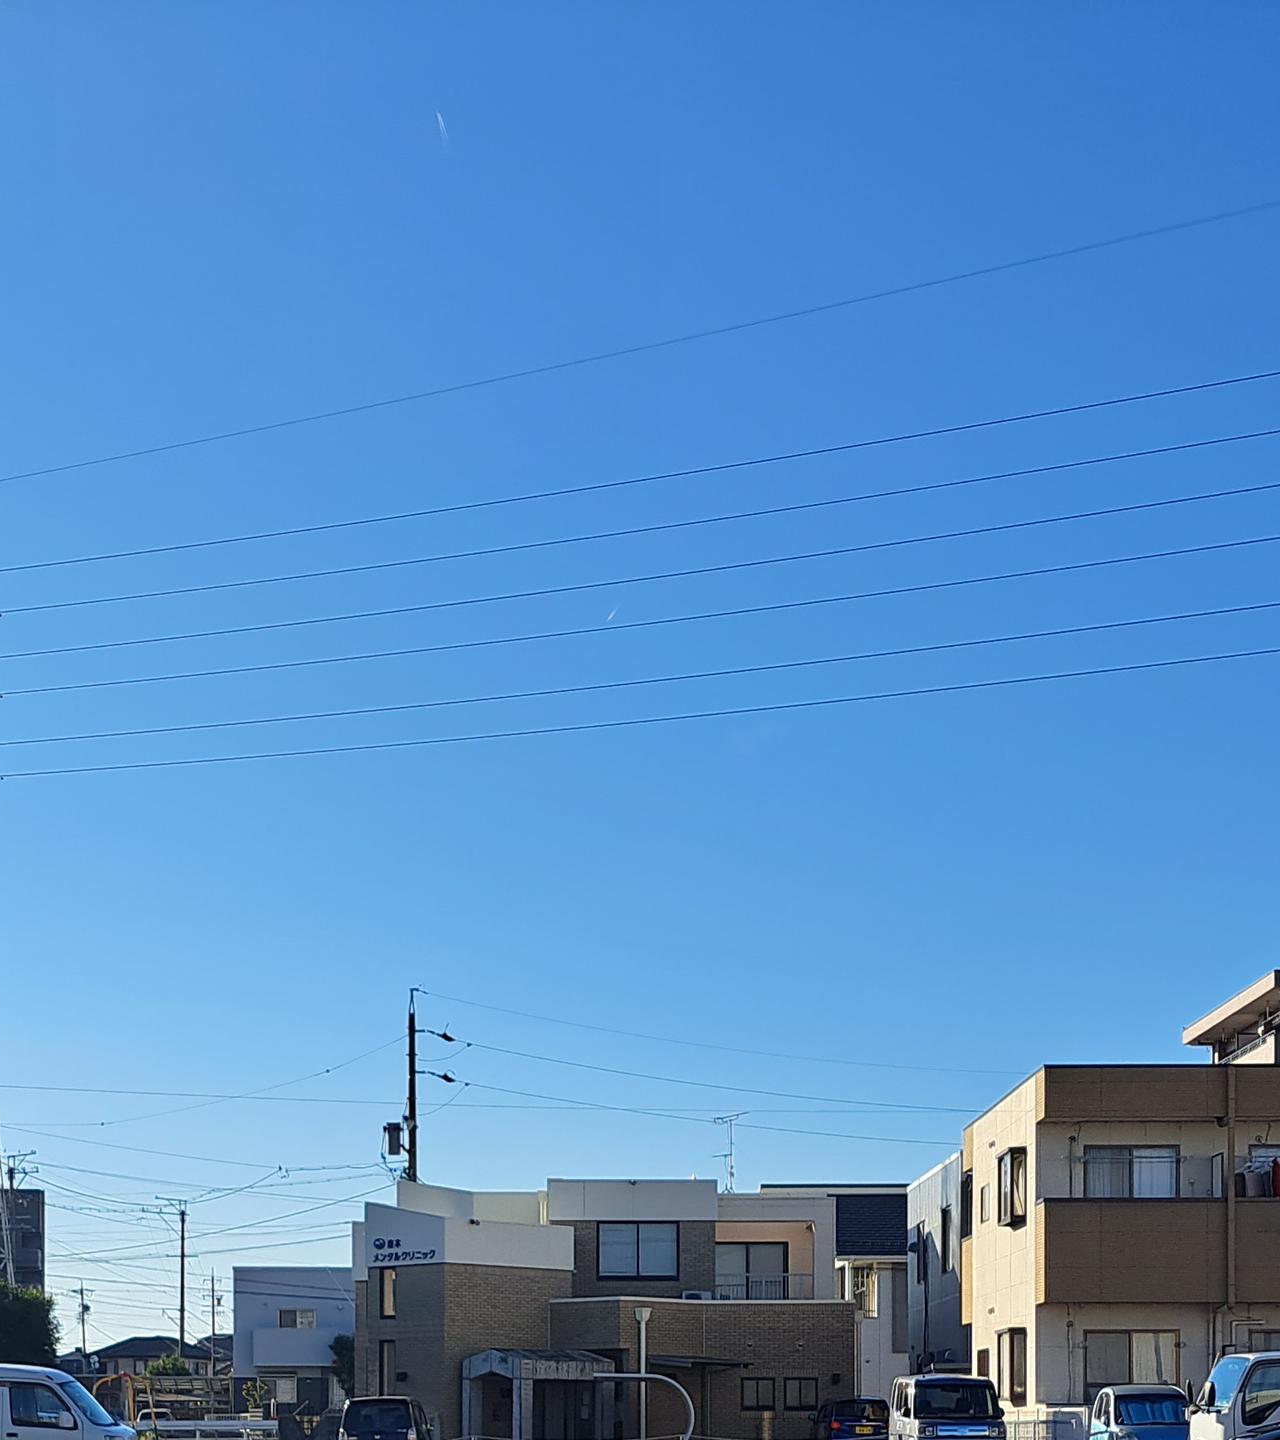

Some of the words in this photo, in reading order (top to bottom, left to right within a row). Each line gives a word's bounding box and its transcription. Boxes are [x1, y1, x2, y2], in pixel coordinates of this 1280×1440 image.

[373, 1249, 436, 1262] メンタルクリニック
